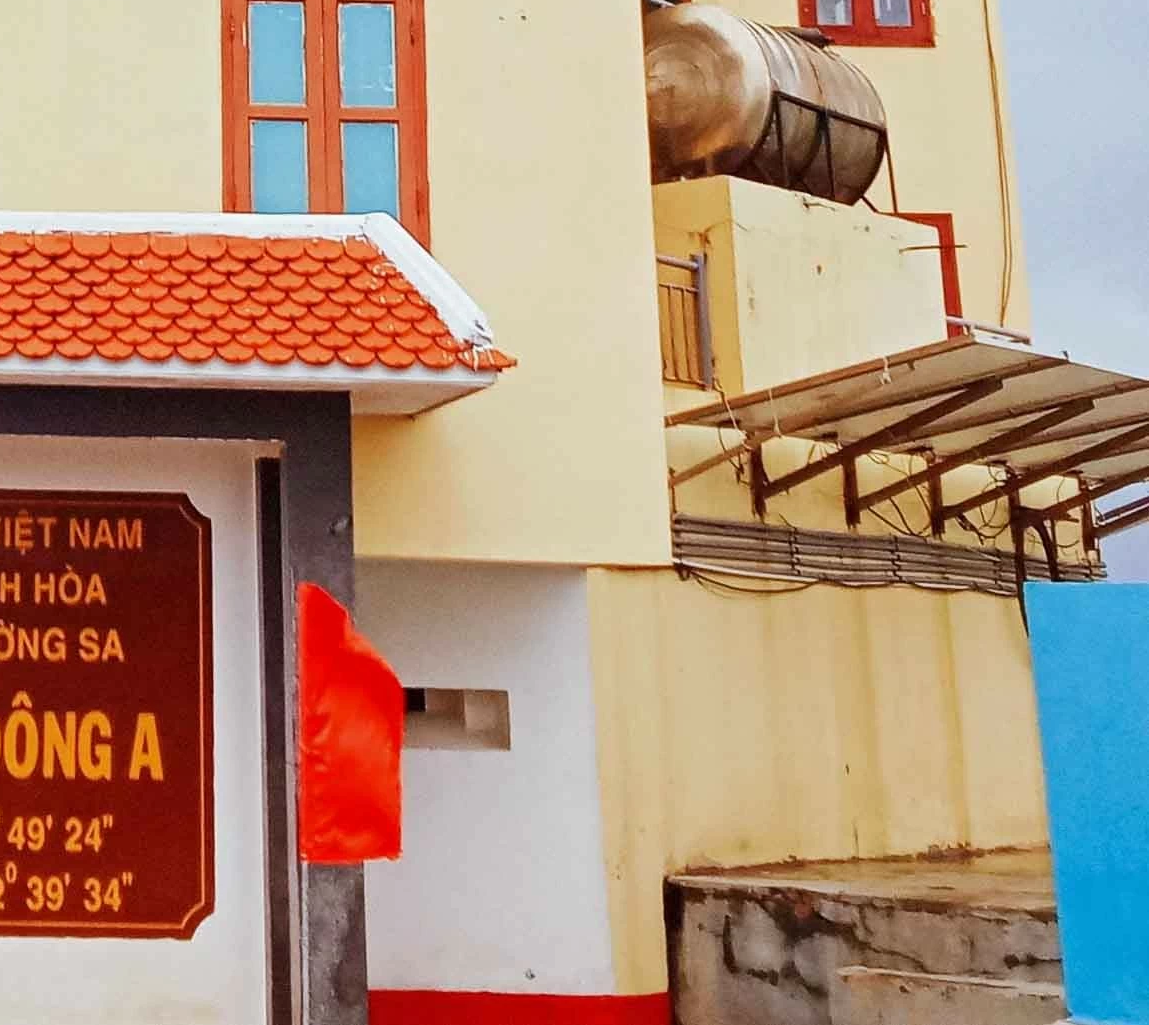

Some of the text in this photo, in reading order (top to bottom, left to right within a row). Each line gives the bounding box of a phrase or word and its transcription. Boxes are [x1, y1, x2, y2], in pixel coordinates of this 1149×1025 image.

[70, 519, 141, 548] NAM
[35, 565, 106, 603] HÒA
[79, 628, 124, 661] SA
[129, 713, 163, 780] A
